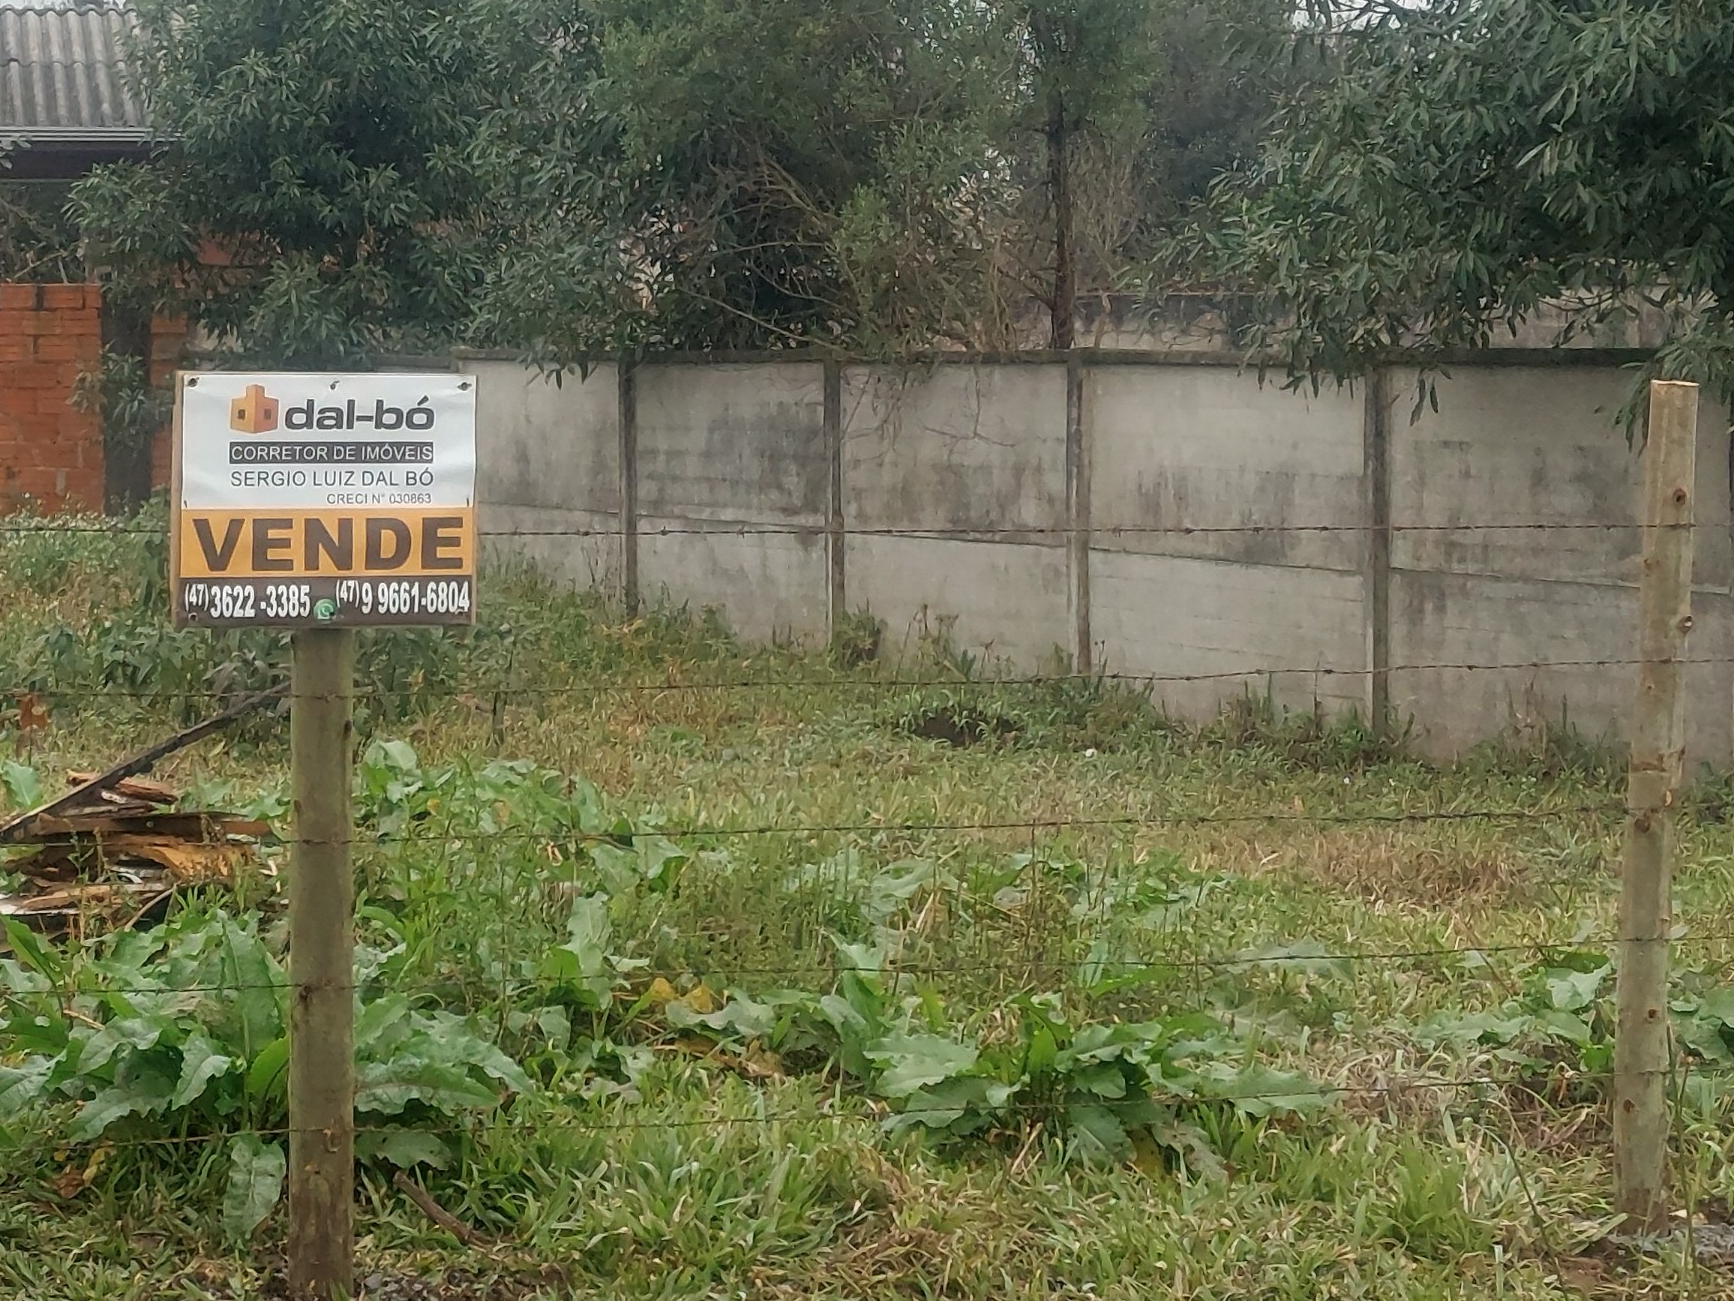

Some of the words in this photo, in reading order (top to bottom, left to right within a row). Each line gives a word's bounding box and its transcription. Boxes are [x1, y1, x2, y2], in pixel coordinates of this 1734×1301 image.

[285, 396, 434, 430] dal-bó
[231, 445, 327, 460] CORRETOR
[334, 446, 356, 460] DE
[362, 444, 432, 460] IMÓVEIS
[231, 471, 306, 487] SERGIO
[313, 471, 356, 486] LUIZ
[362, 471, 399, 486] DAL
[406, 467, 433, 486] BÓ
[327, 494, 367, 504] CRECI
[389, 493, 431, 504] 030863
[193, 517, 464, 572] VENDE
